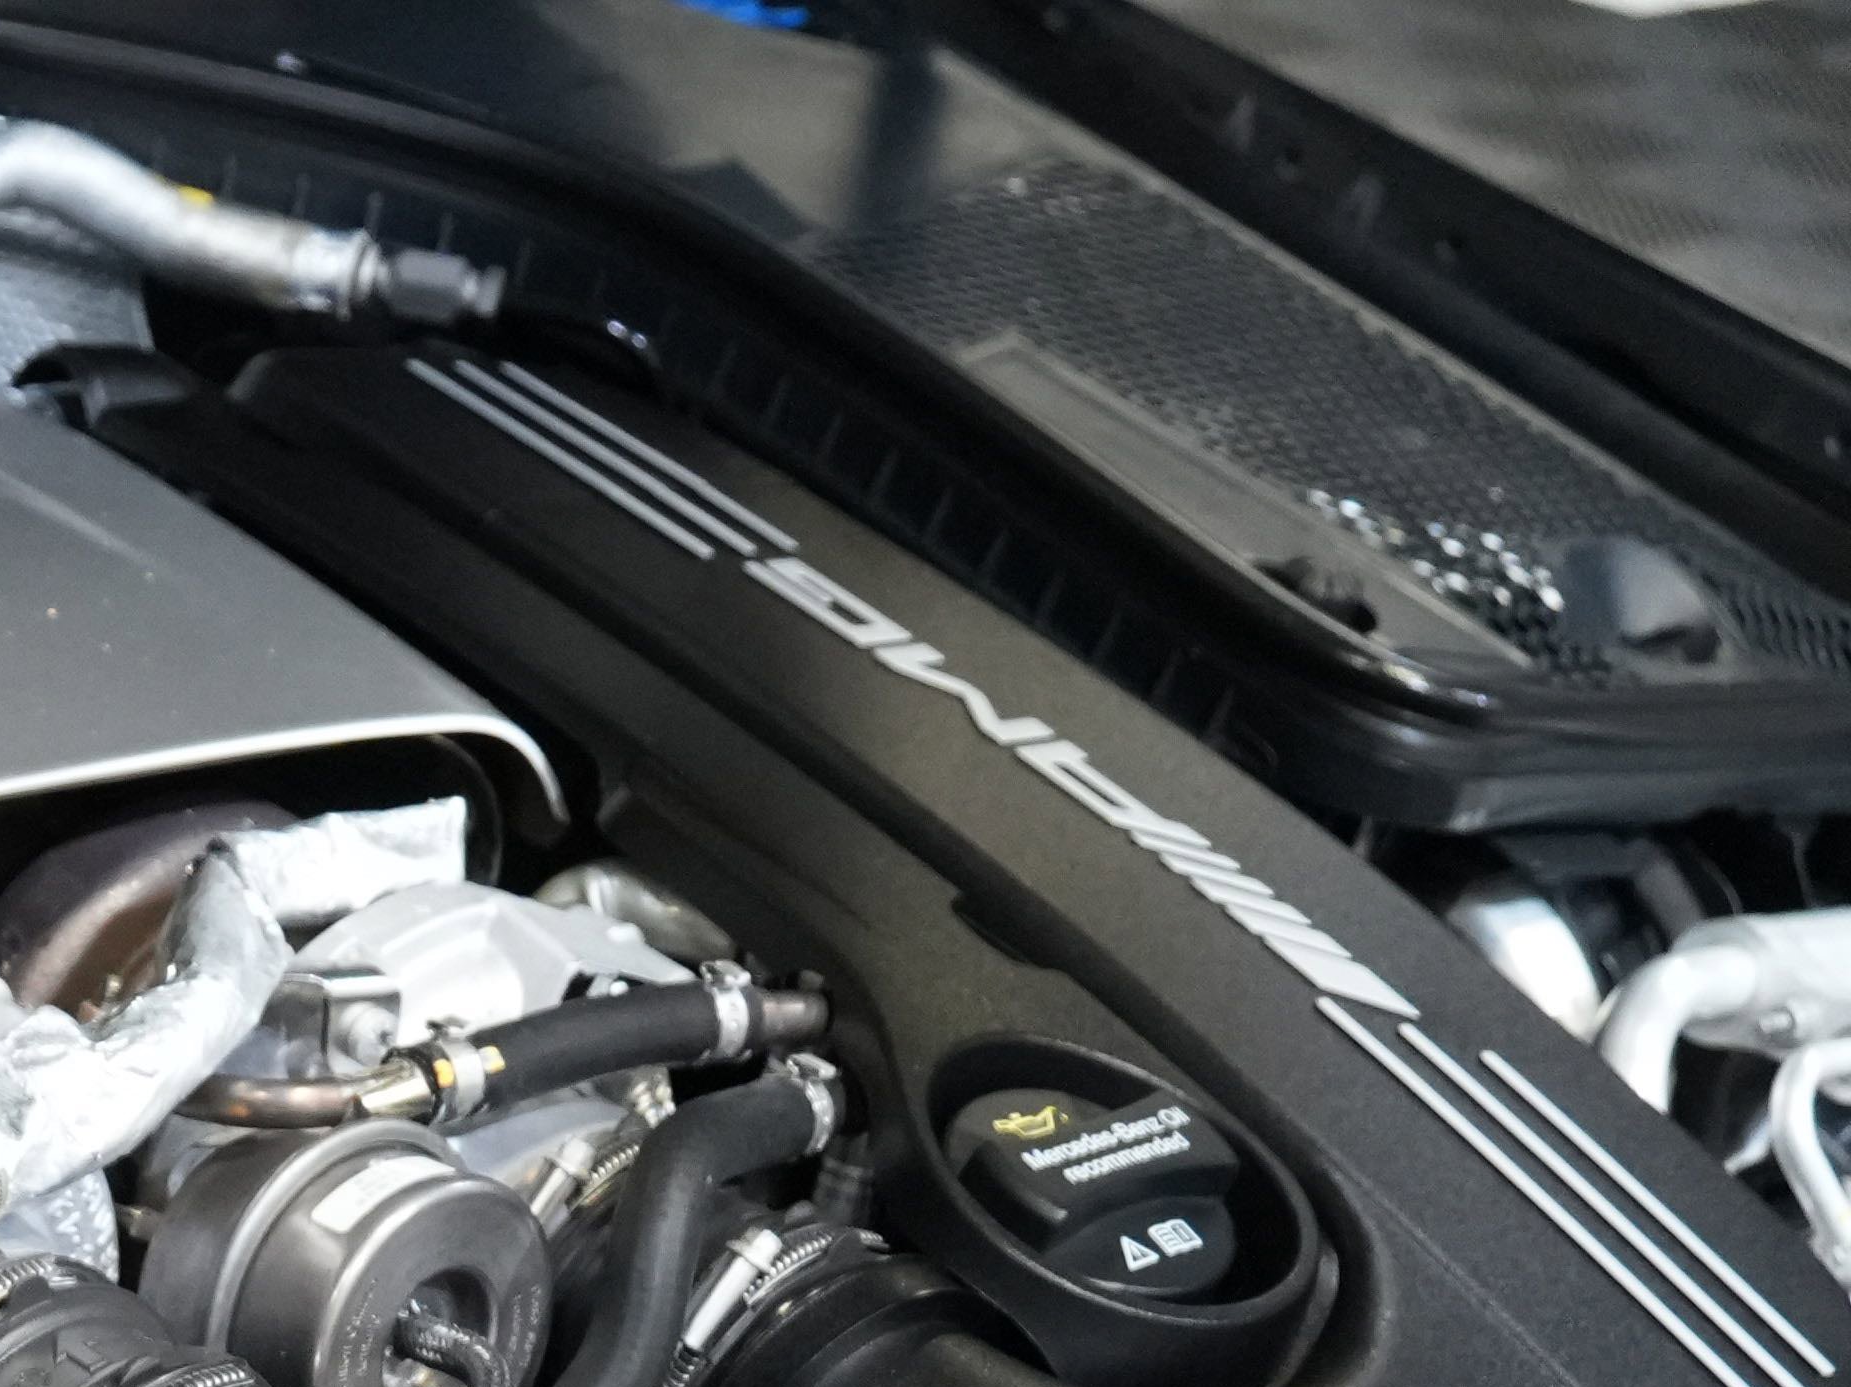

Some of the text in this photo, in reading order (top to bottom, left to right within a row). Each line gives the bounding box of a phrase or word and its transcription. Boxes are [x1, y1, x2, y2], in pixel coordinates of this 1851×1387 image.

[1021, 1105, 1191, 1171] Mercedes-Benz Oil
[1062, 1130, 1191, 1185] recommended
